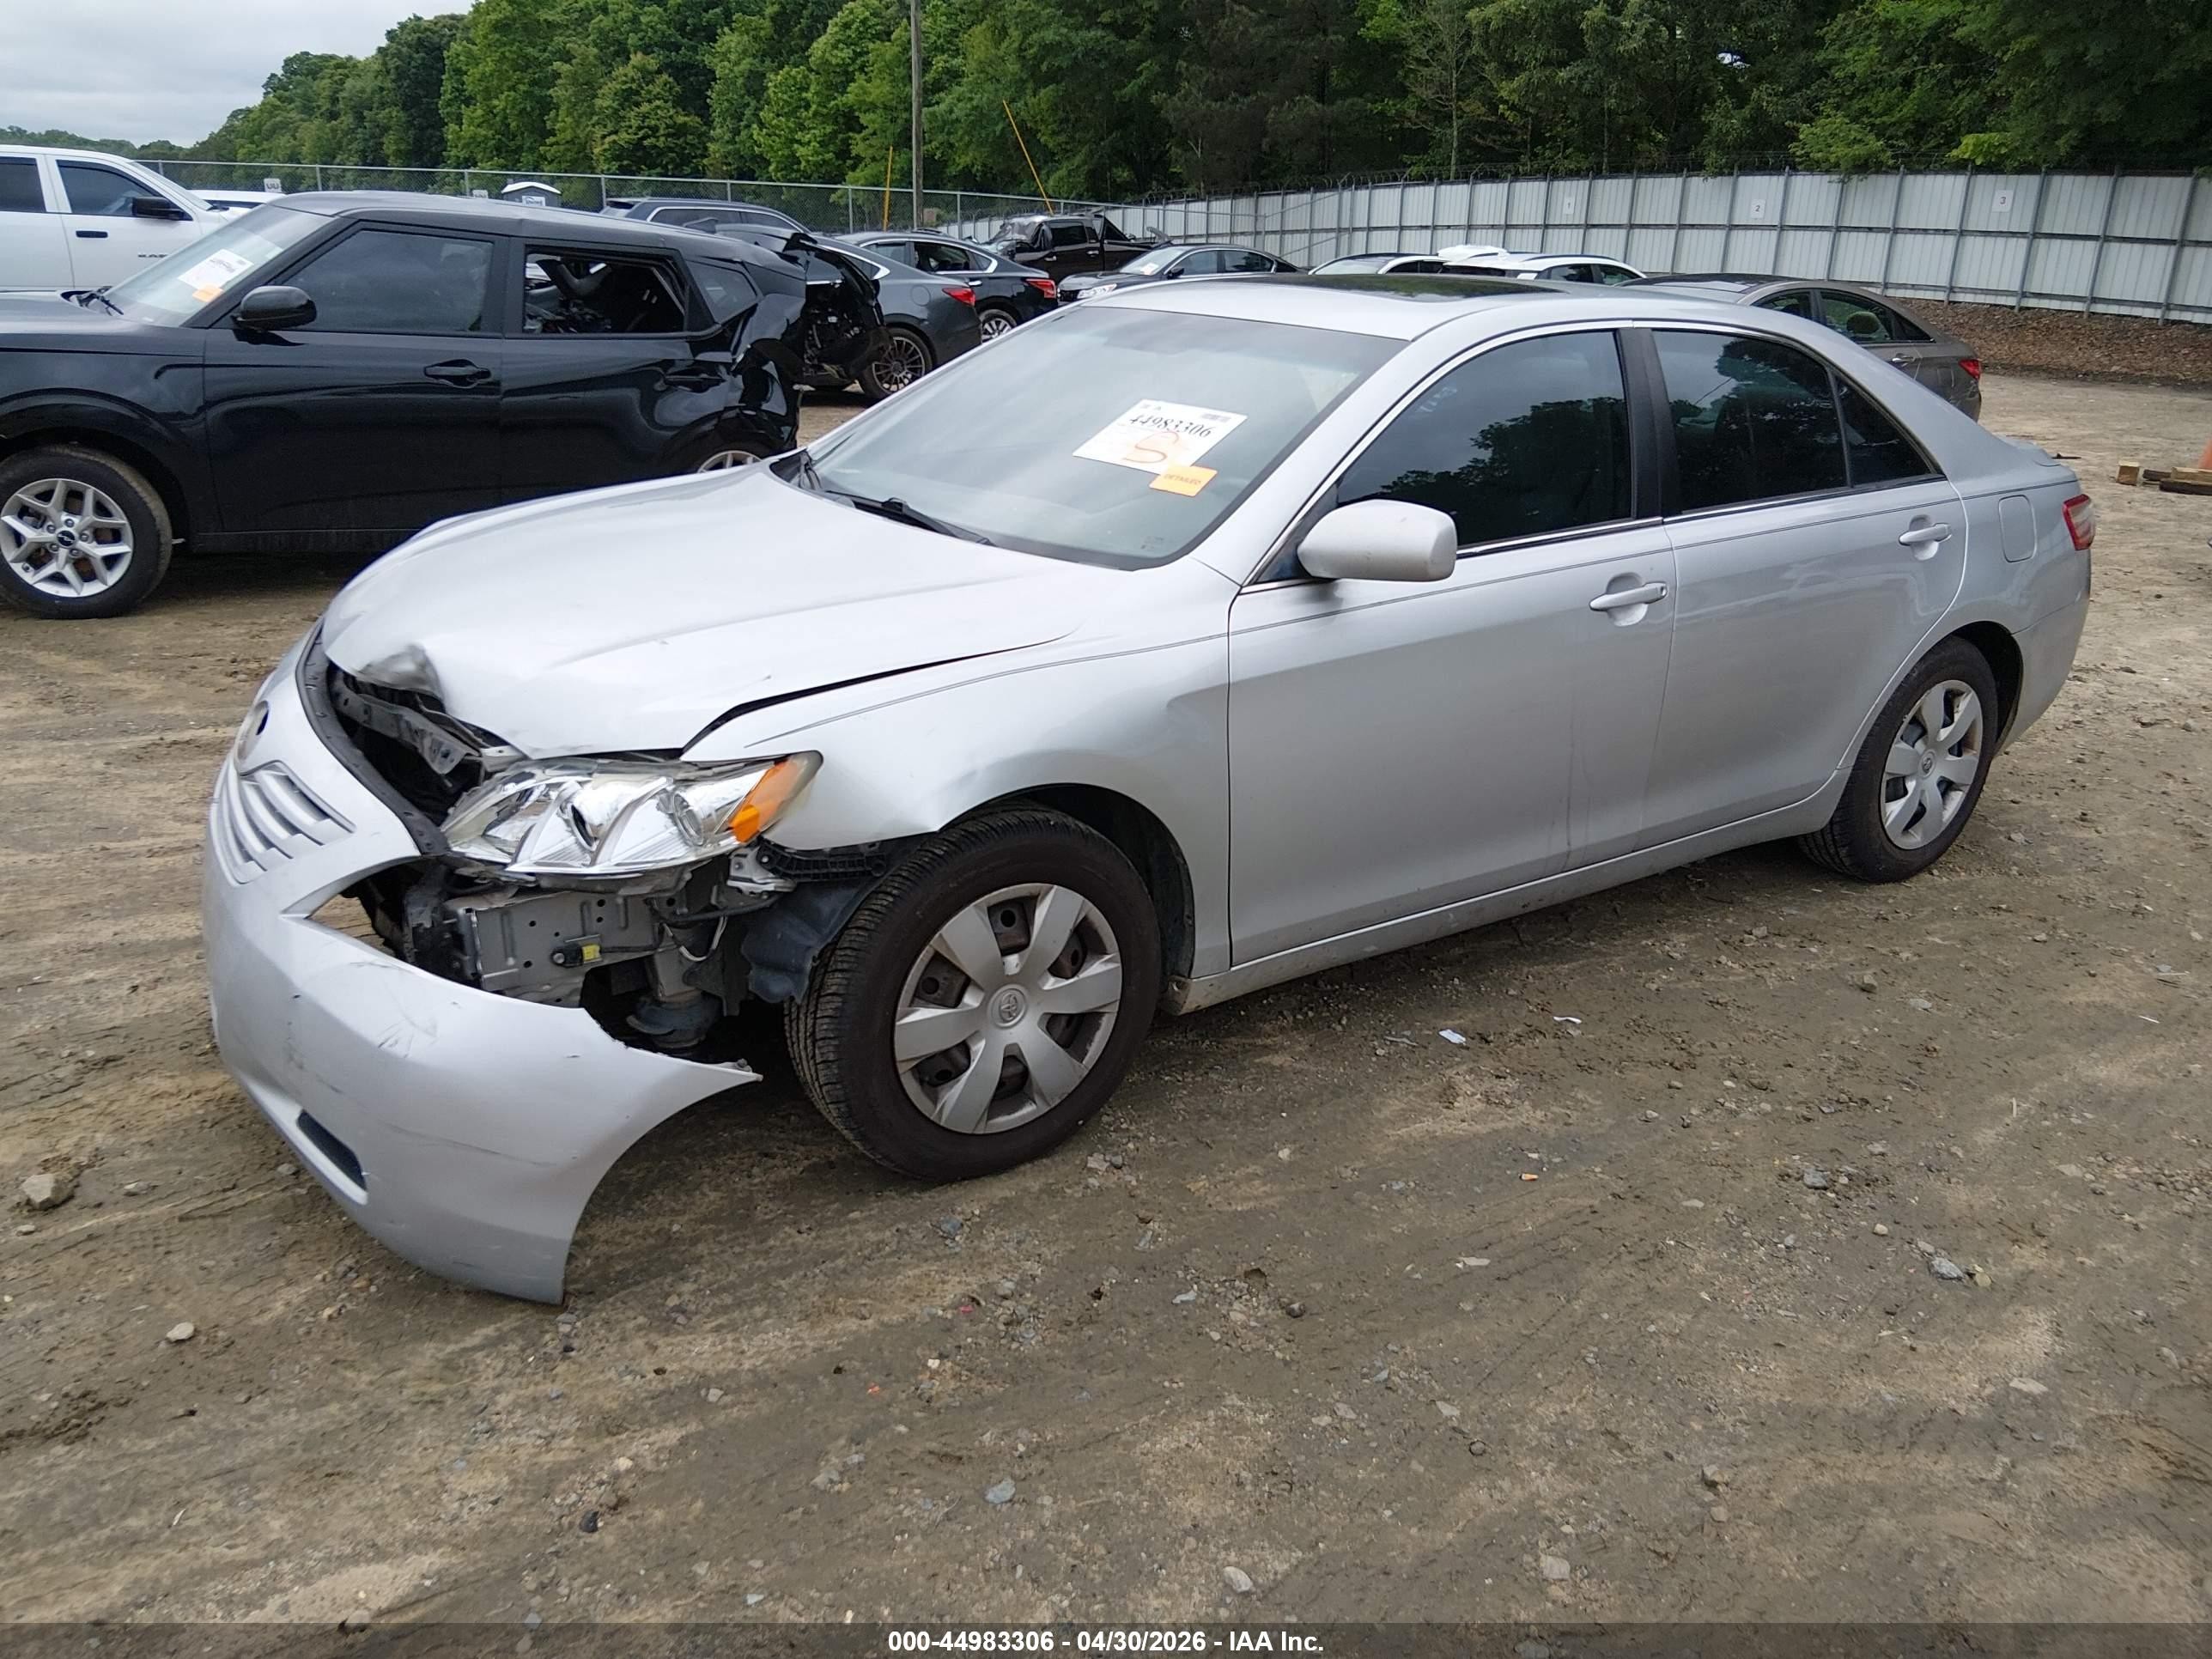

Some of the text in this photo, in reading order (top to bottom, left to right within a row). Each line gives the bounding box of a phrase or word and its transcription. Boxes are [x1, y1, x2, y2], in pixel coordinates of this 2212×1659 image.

[1999, 196, 2007, 205] 3
[1754, 204, 1761, 213] 2
[1129, 414, 1216, 439] 44983306
